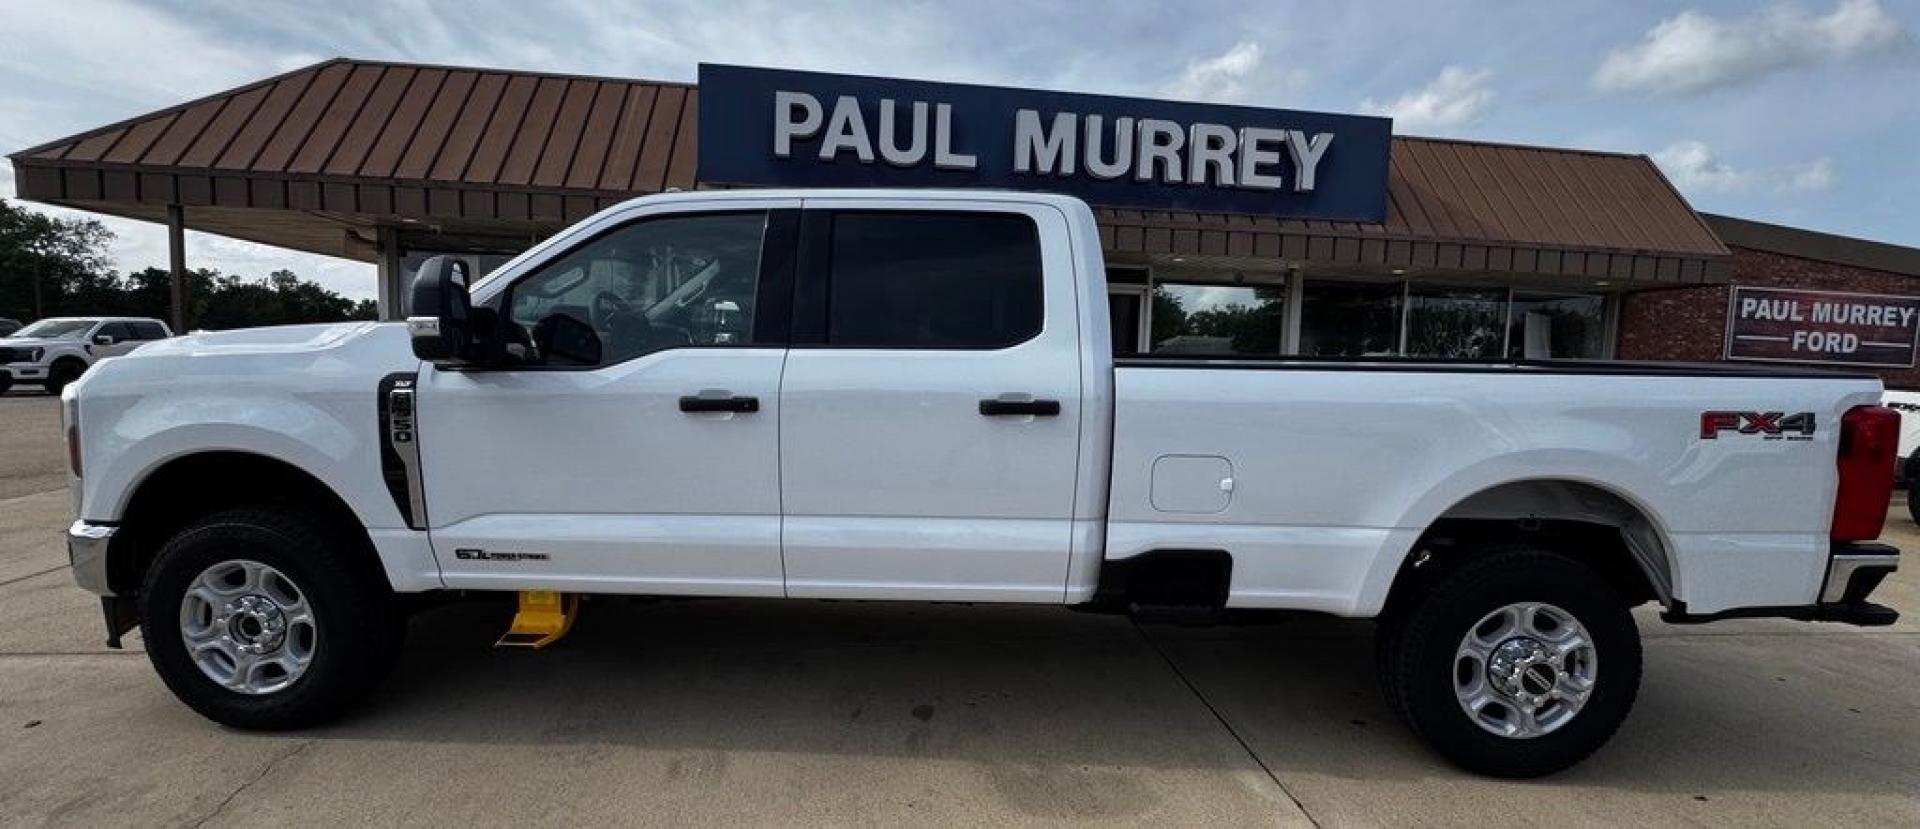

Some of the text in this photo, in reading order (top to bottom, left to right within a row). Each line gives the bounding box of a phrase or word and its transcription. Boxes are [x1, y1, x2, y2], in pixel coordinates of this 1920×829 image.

[773, 90, 1335, 192] PAUL MURREY
[1741, 298, 1915, 328] PAUL MURREY
[1792, 330, 1859, 354] FORD
[1700, 411, 1816, 439] FX4
